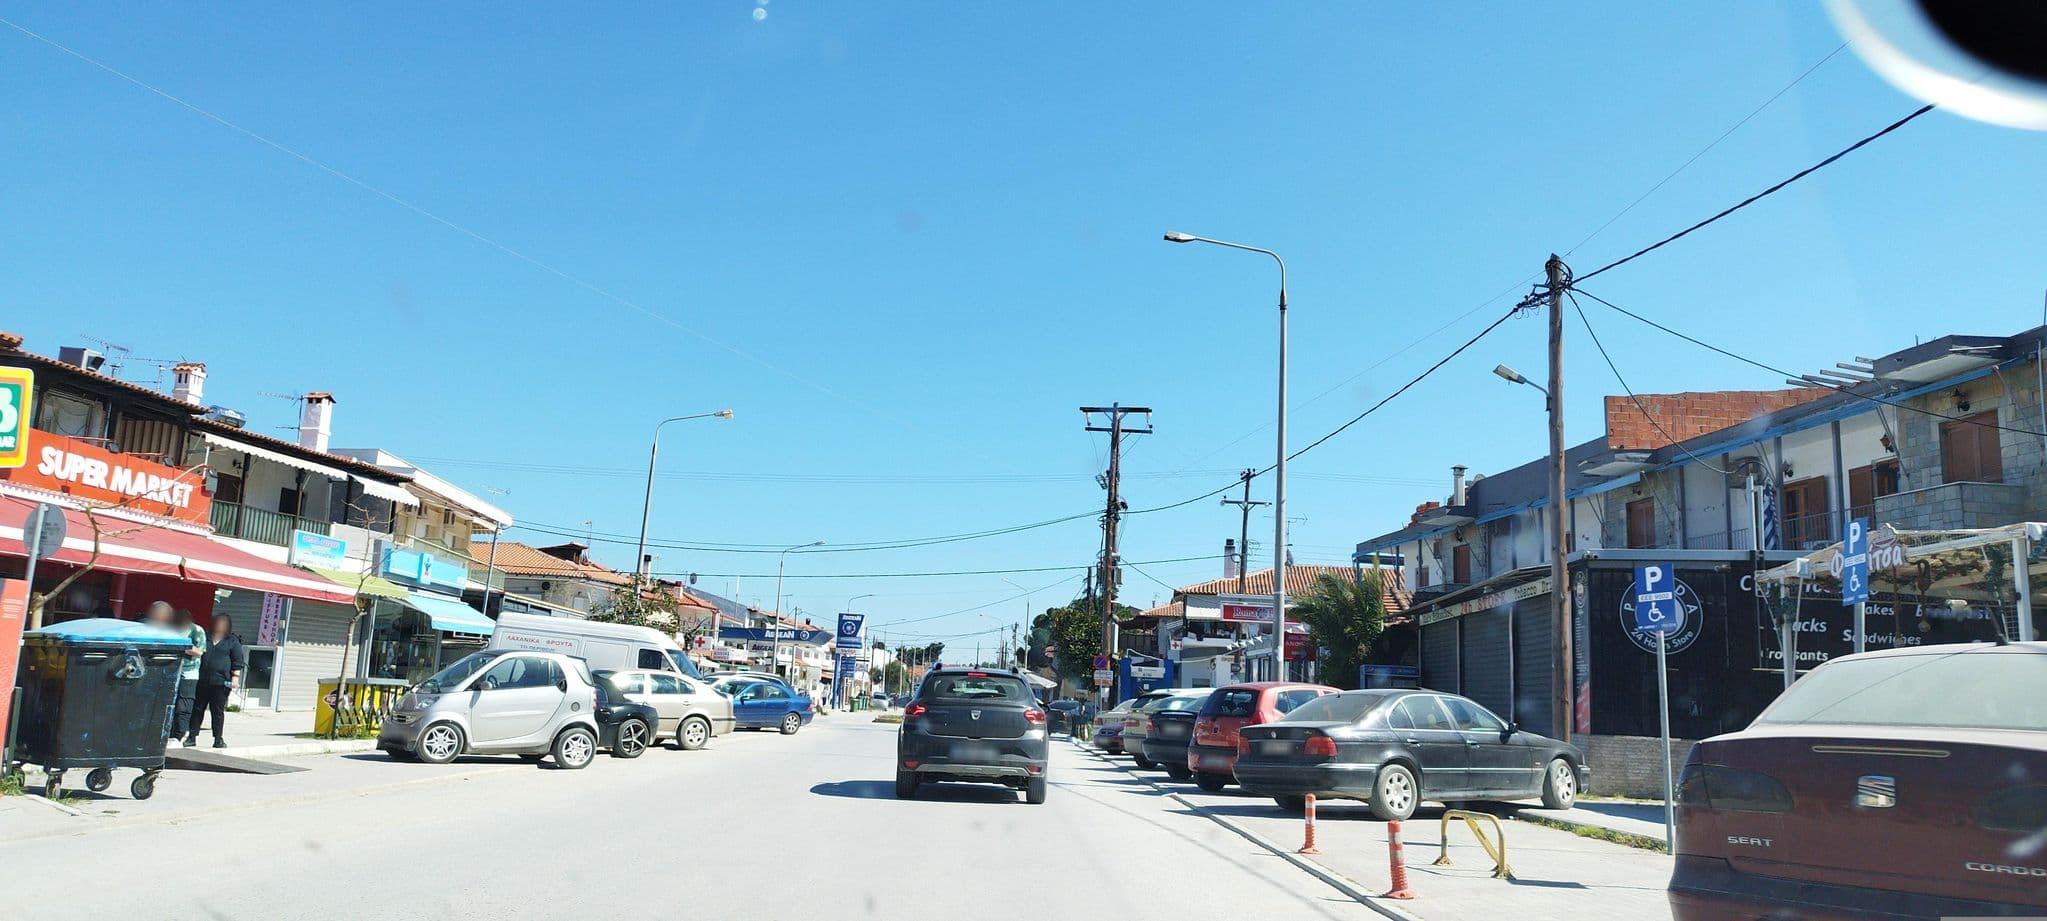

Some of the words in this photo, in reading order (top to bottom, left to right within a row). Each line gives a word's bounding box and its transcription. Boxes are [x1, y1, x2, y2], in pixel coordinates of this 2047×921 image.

[38, 446, 109, 490] SUPER
[109, 465, 194, 508] MARKET
[1849, 522, 1860, 553] P
[1645, 567, 1663, 591] P
[1865, 604, 1895, 616] akes
[765, 630, 795, 639] AEEAN
[1644, 636, 1671, 650] Hos
[1672, 630, 1694, 648] Store
[752, 643, 774, 651] AEGEA
[1728, 836, 1773, 847] SEAT
[1965, 861, 2047, 877] CORDO
